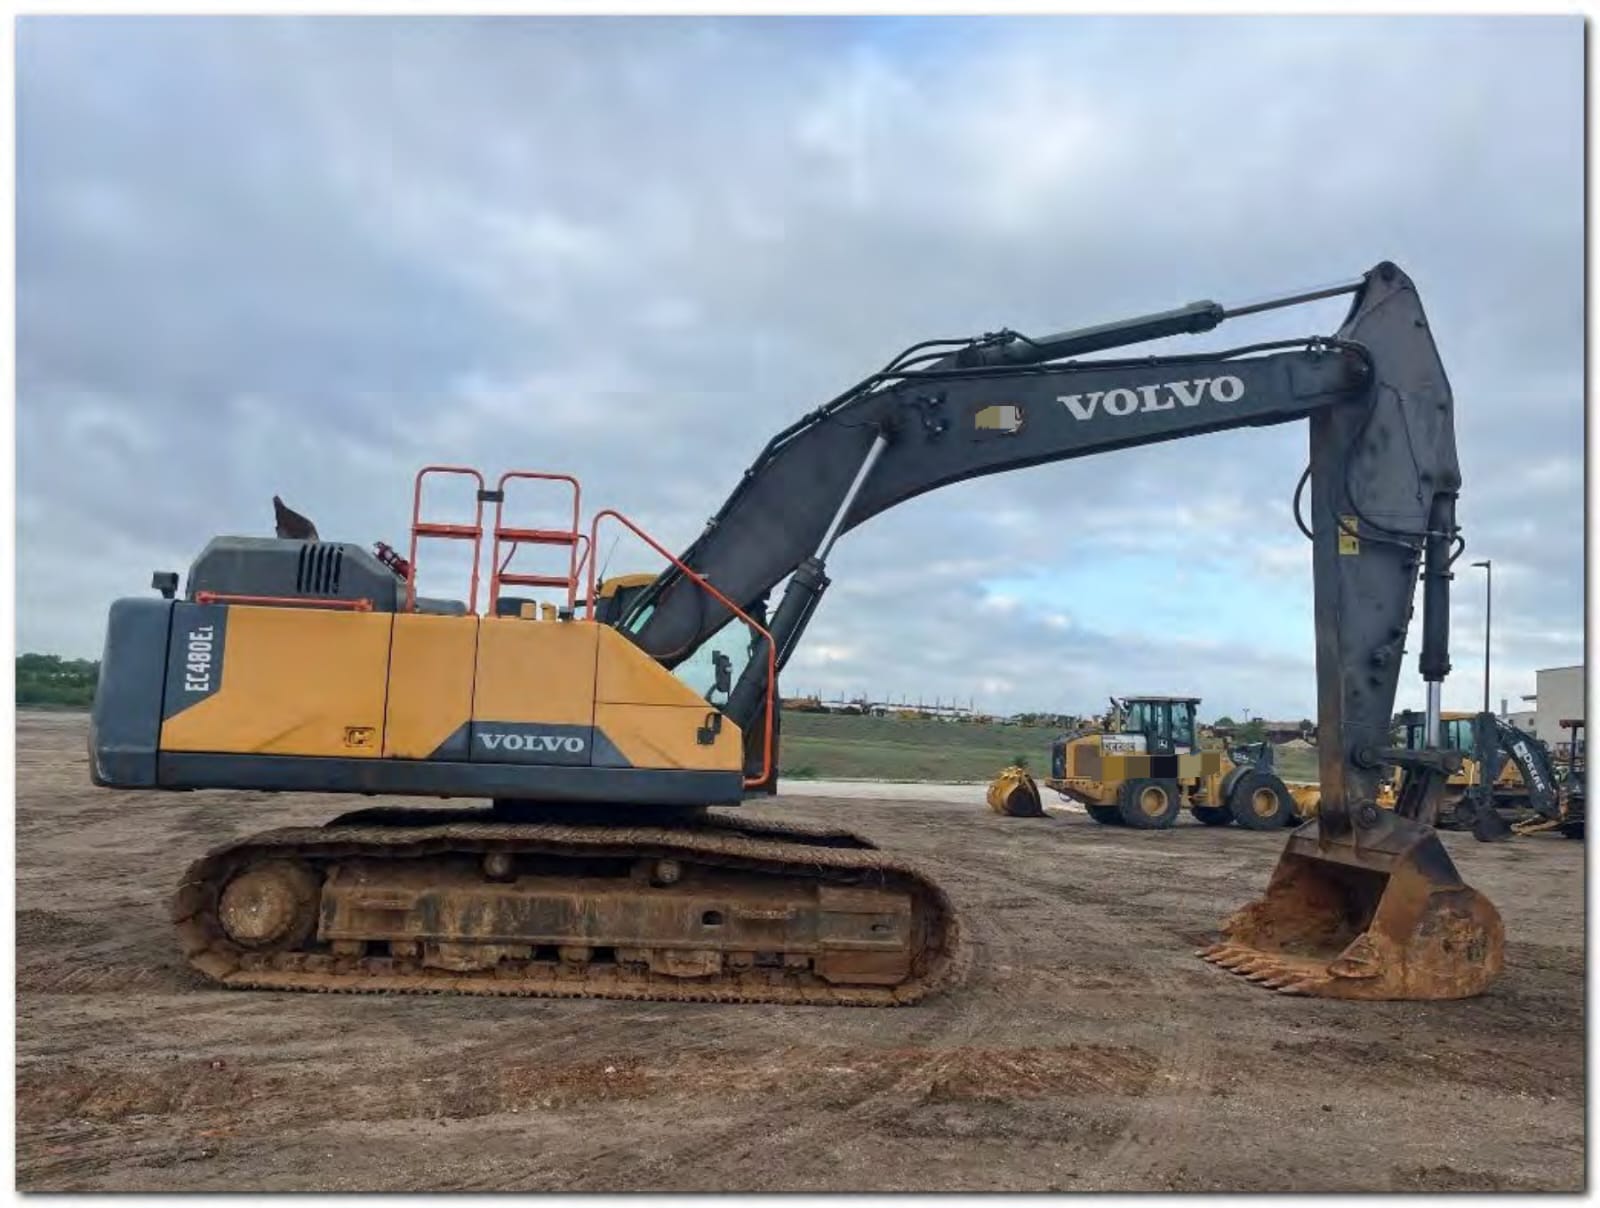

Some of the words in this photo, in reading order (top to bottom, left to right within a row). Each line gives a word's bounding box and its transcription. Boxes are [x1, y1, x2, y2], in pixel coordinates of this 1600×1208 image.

[1056, 376, 1245, 420] VOLVO
[477, 733, 585, 752] VOLVO
[1523, 753, 1545, 792] DEERE
